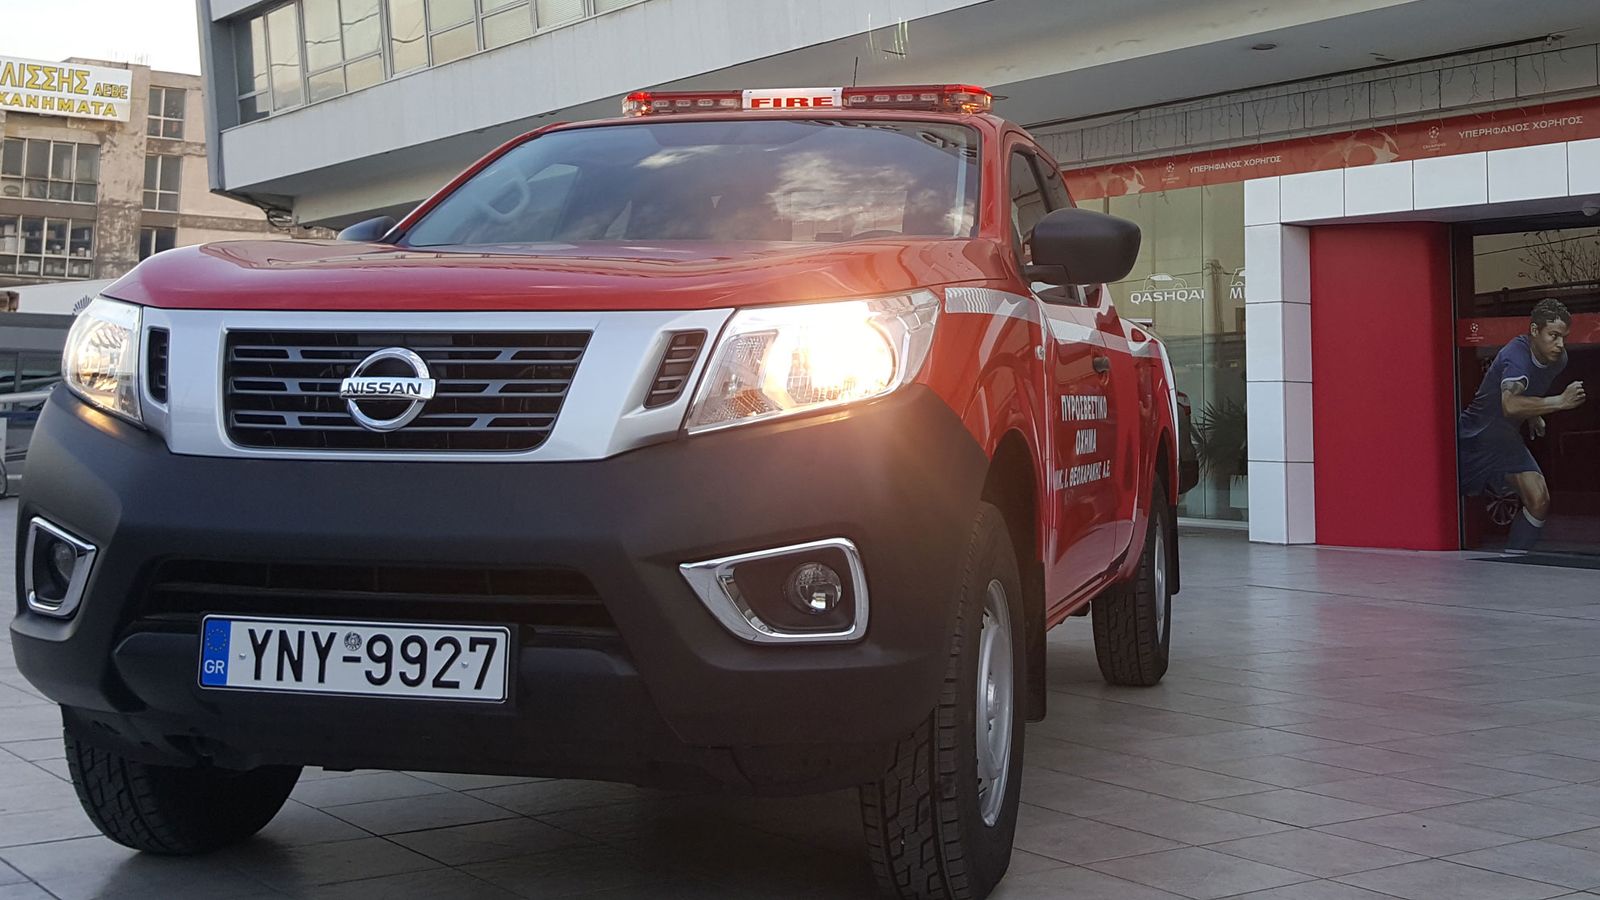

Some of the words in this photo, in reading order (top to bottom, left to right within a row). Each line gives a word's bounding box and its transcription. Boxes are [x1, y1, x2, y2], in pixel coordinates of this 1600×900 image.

[0, 61, 90, 94] ΛΙΣΣΗΣ
[751, 96, 833, 108] FIRE
[1532, 115, 1584, 130] ΧΟΡΗΓΟΣ
[1130, 289, 1206, 305] QASHQAI
[346, 382, 422, 395] NISSAN
[204, 659, 225, 675] GR
[248, 628, 498, 690] YNY-9927
